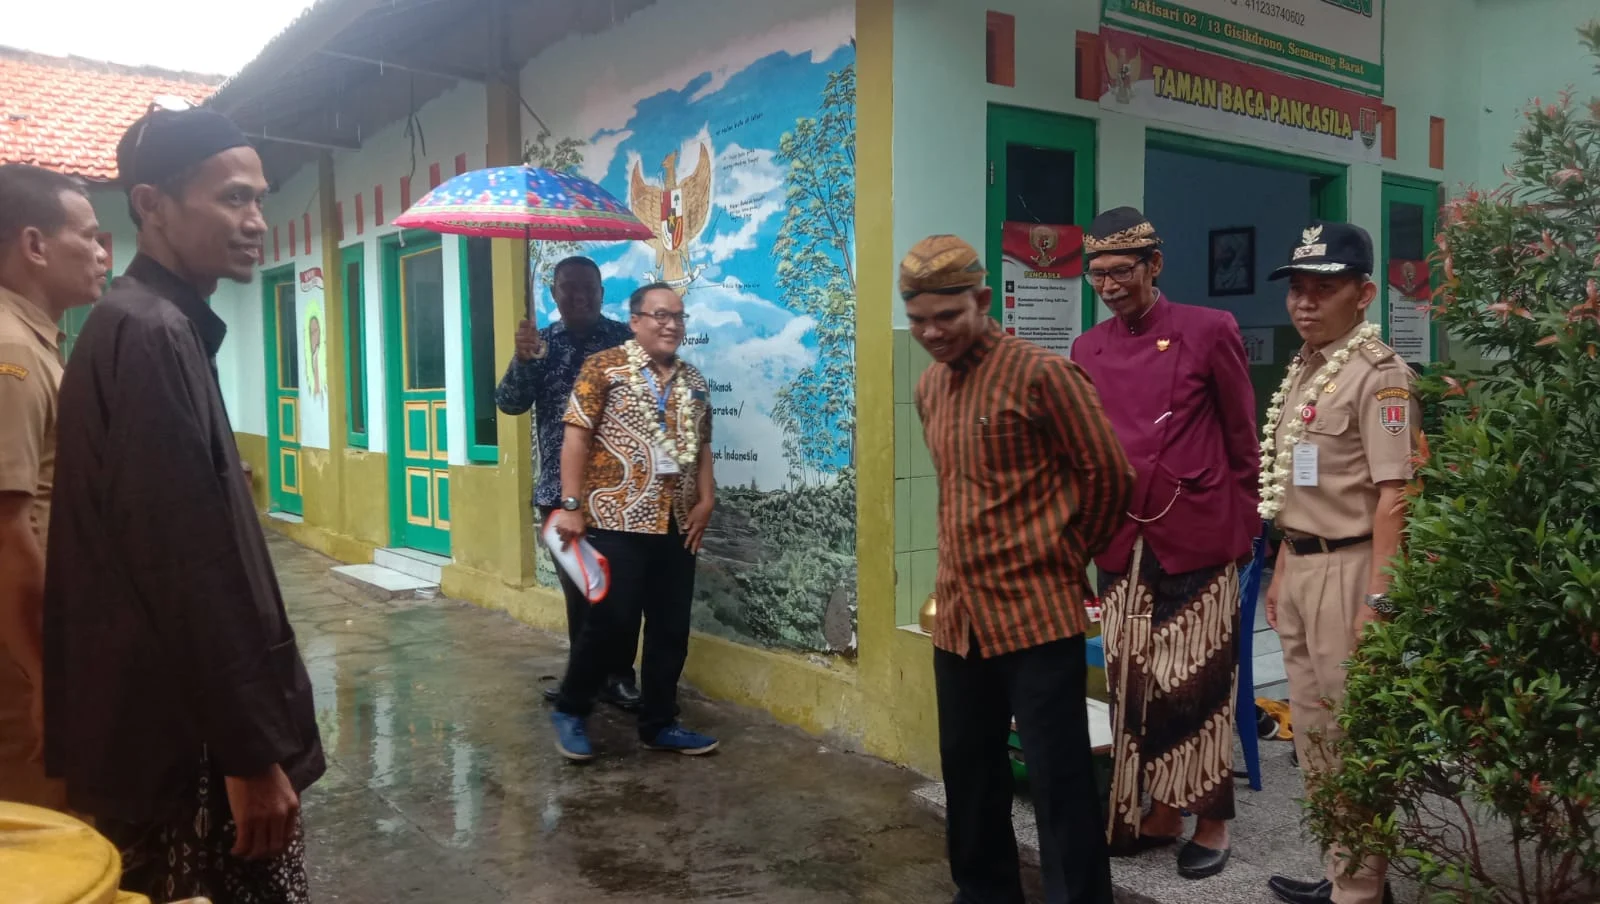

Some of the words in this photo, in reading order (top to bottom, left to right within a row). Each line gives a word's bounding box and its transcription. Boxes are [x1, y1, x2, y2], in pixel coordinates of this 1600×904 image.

[1131, 0, 1180, 22] Jatisari
[1183, 12, 1197, 27] 02
[1207, 20, 1221, 34] 13
[1224, 23, 1285, 54] Gisikdrono,
[1288, 41, 1337, 71] Semarang
[1339, 57, 1365, 75] Barat
[1152, 65, 1219, 109] TAMAN
[1221, 83, 1268, 121] BACA
[1270, 94, 1354, 141] PANCASILA
[724, 446, 758, 462] Indonesia
